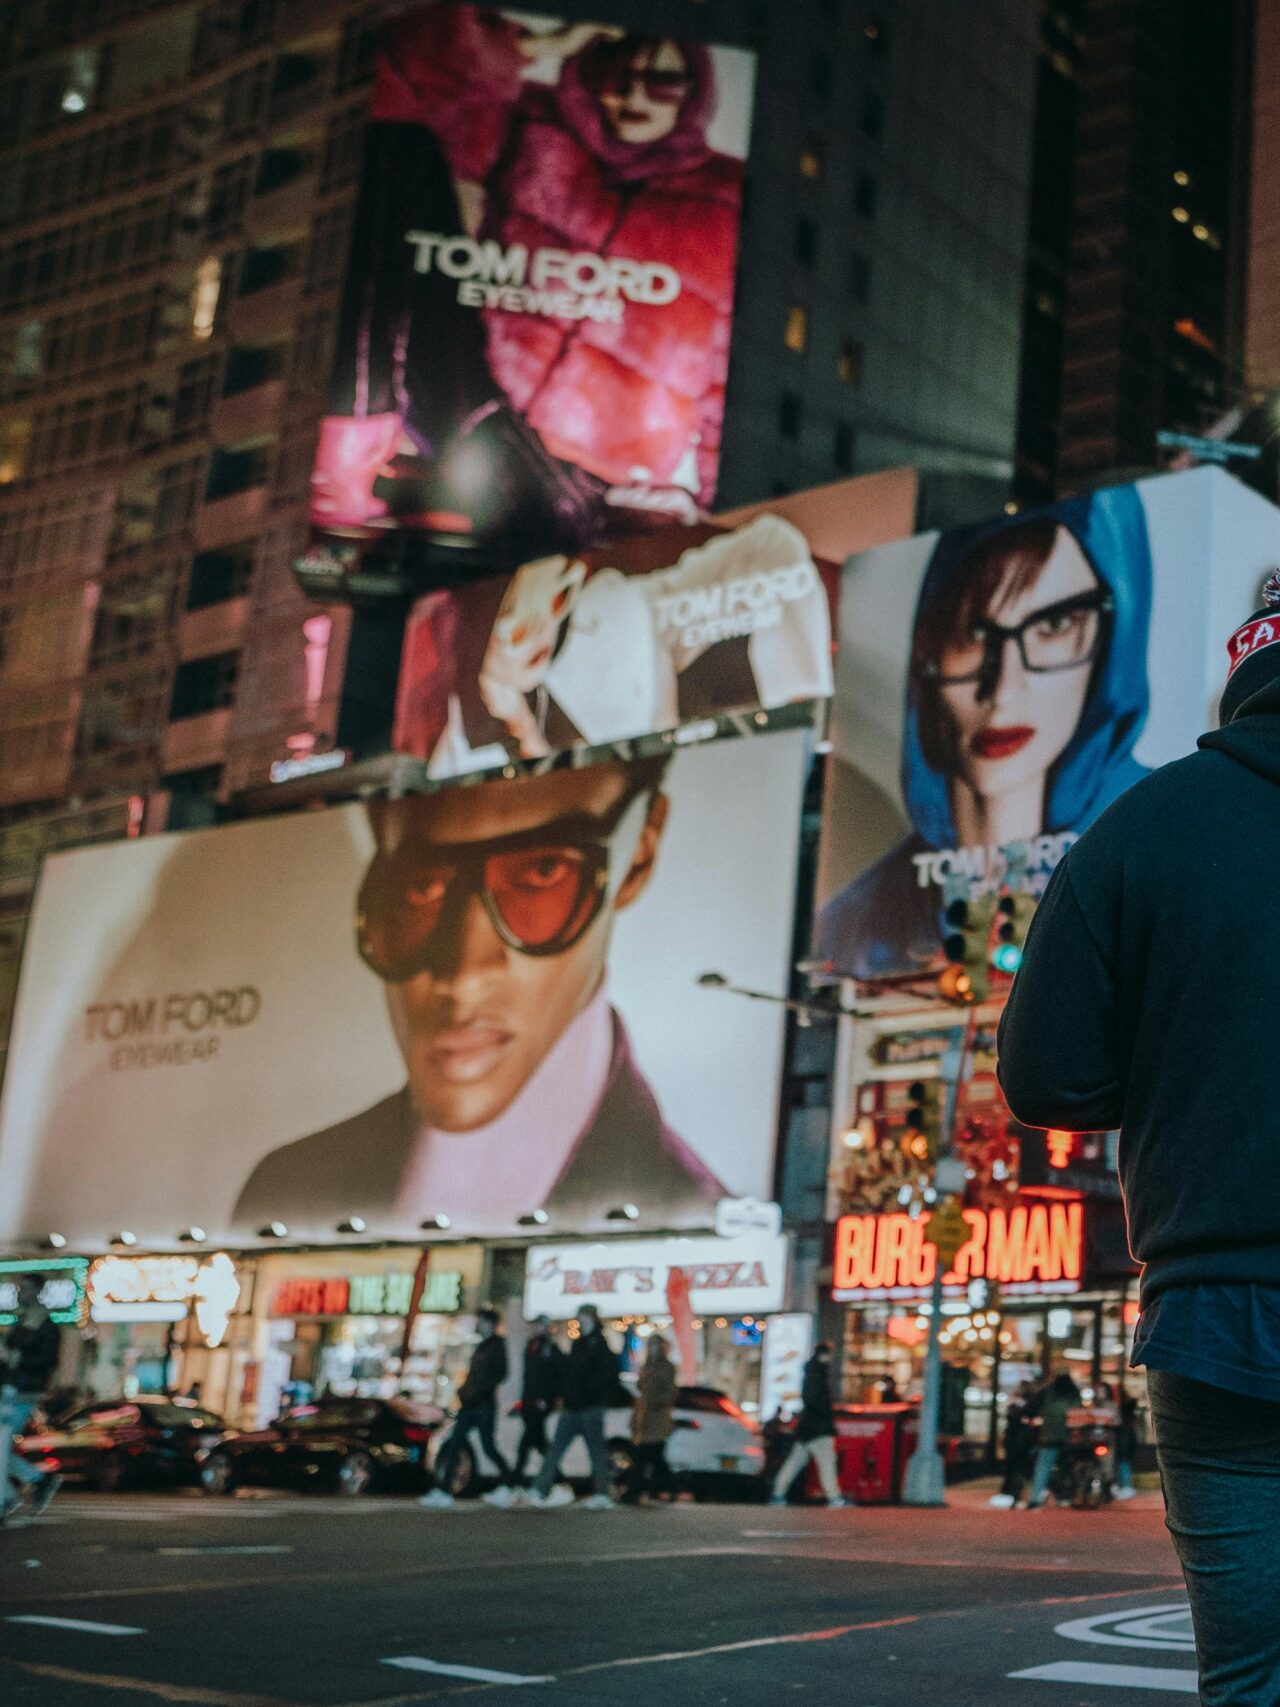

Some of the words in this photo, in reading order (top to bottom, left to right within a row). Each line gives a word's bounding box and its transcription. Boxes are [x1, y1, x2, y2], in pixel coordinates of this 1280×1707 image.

[404, 229, 528, 288] TOM
[532, 248, 681, 305] FORD
[456, 280, 624, 324] EYEWEAR
[655, 584, 722, 632] TOM
[725, 563, 816, 617] FORD
[911, 844, 985, 889] TOM
[987, 831, 1082, 880] FRD
[84, 996, 157, 1042] TOM
[159, 984, 262, 1034] FORD
[665, 1261, 769, 1293] IZZA
